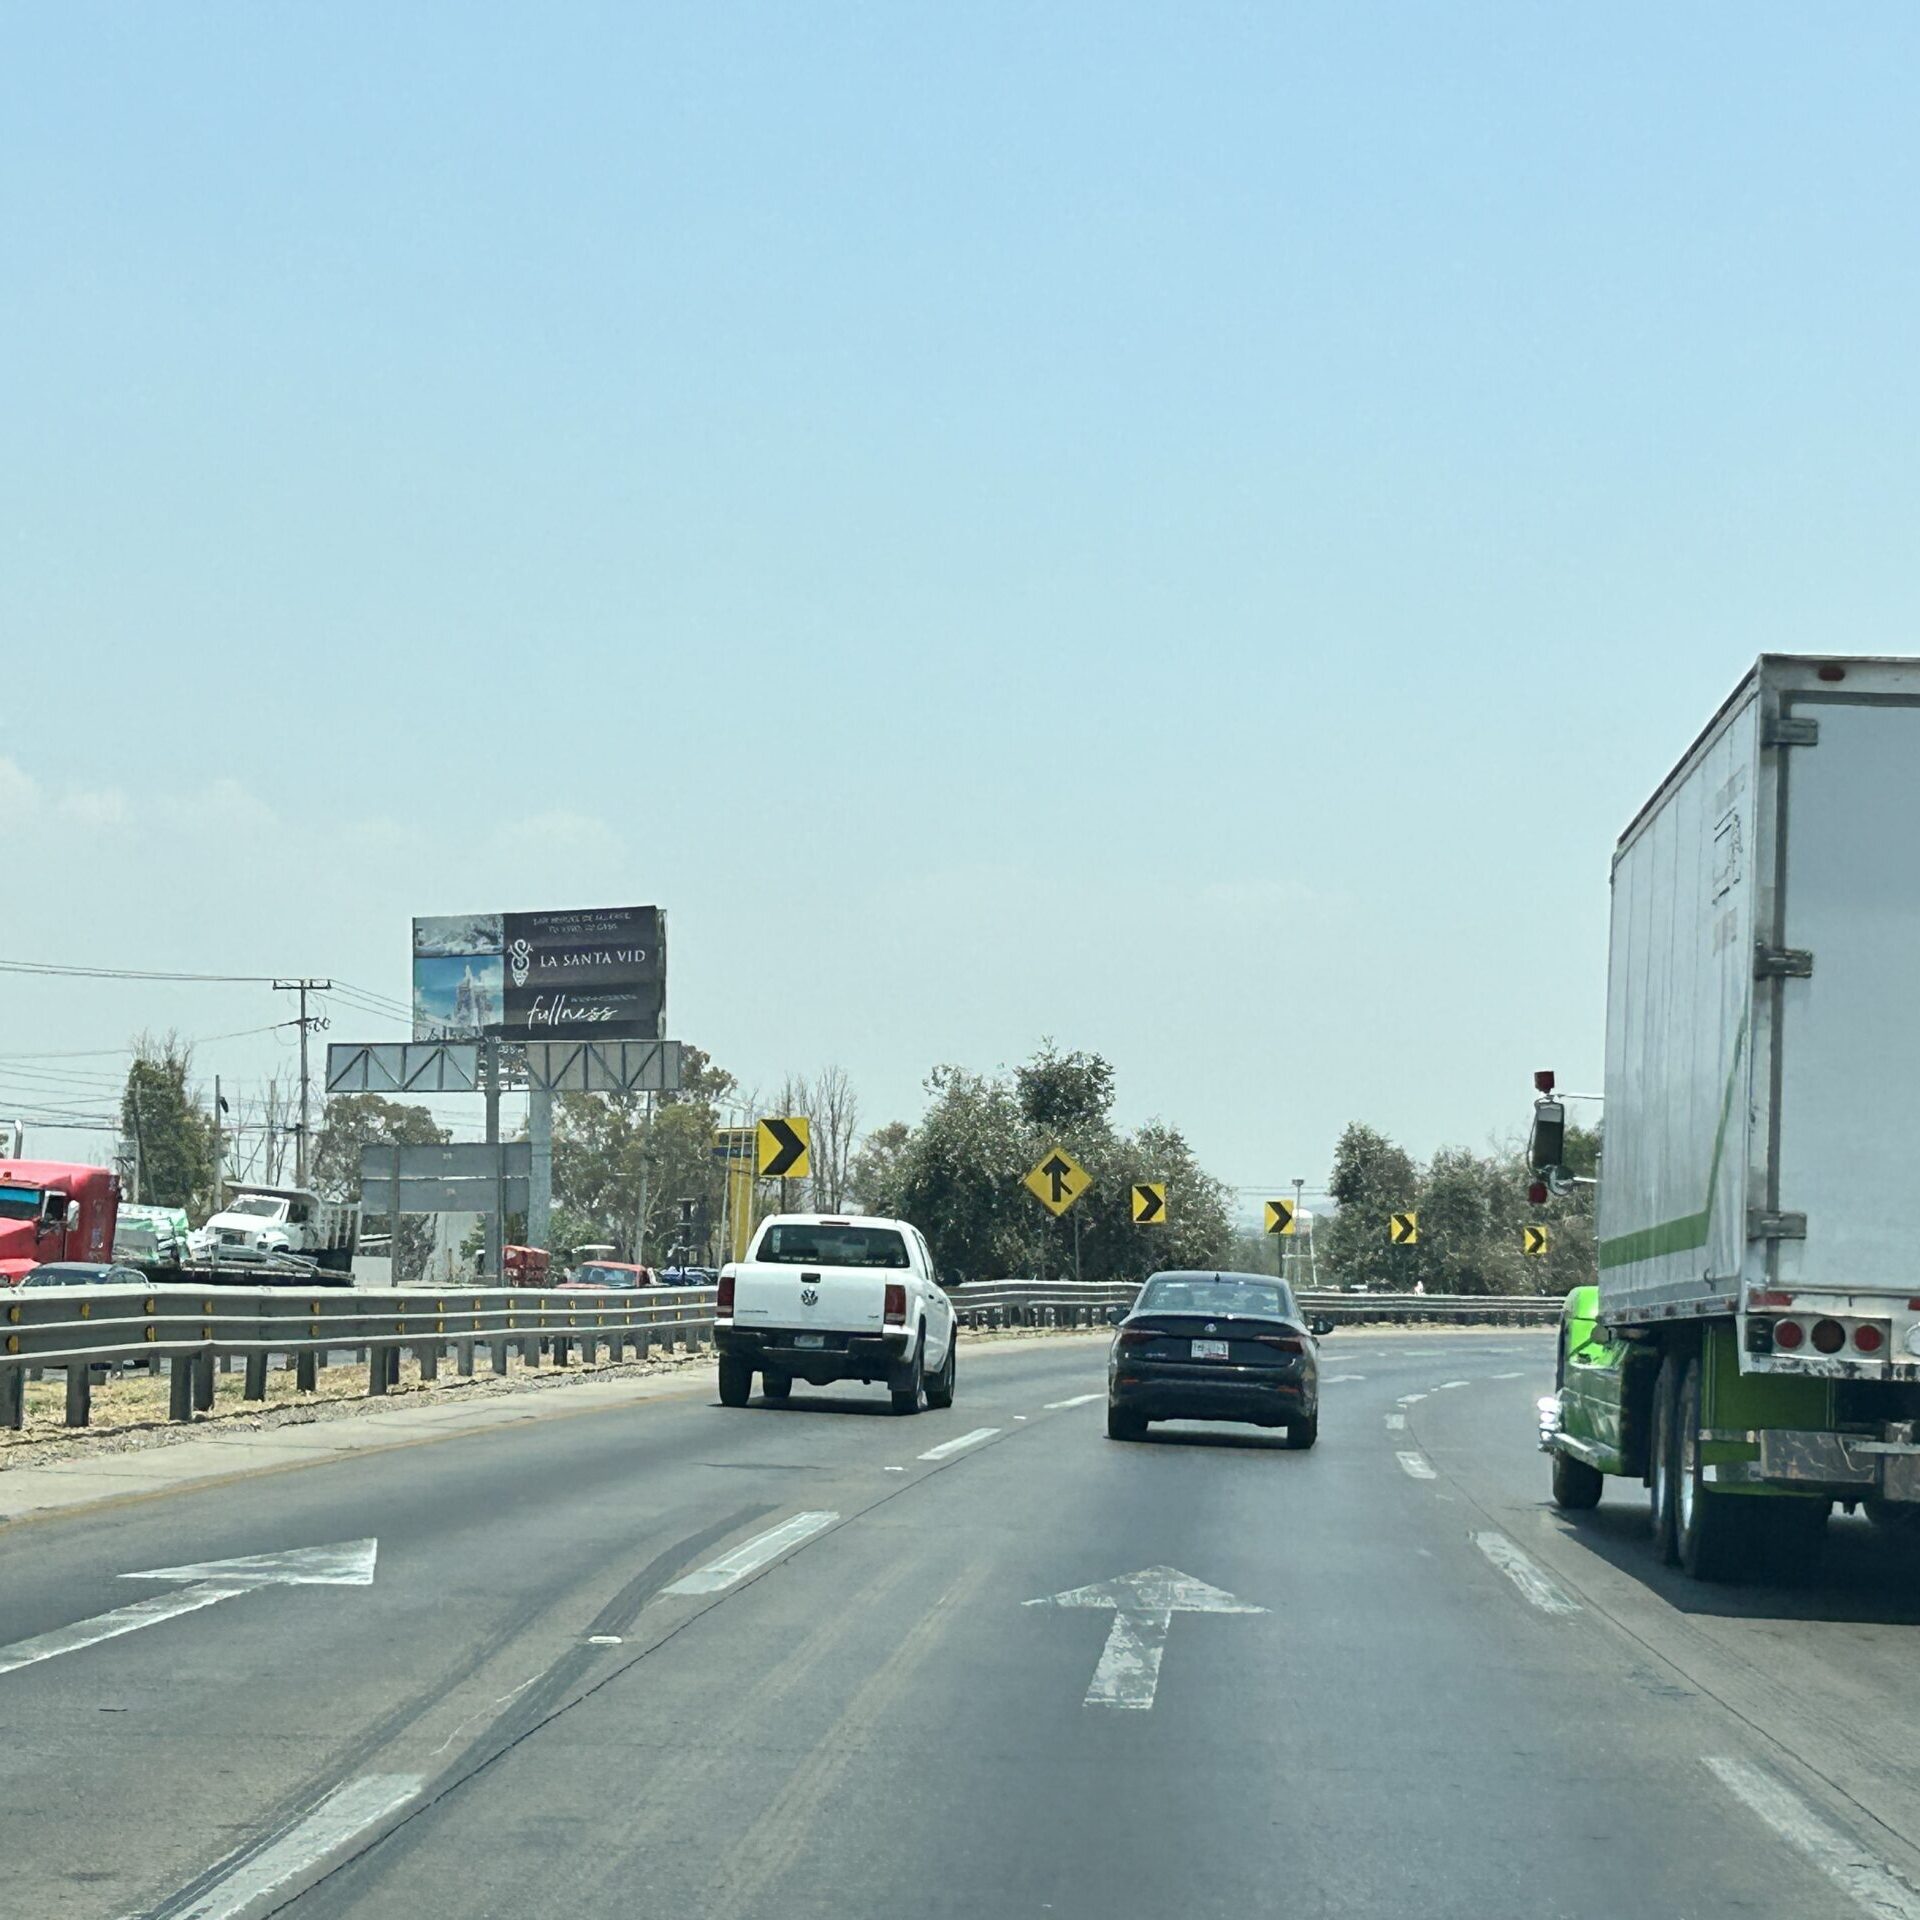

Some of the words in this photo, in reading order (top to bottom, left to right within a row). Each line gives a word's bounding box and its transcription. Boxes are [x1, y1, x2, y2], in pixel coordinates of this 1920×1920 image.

[540, 955, 558, 968] LA
[563, 952, 612, 967] SANTA
[616, 949, 646, 963] VID
[527, 994, 619, 1030] fullness
